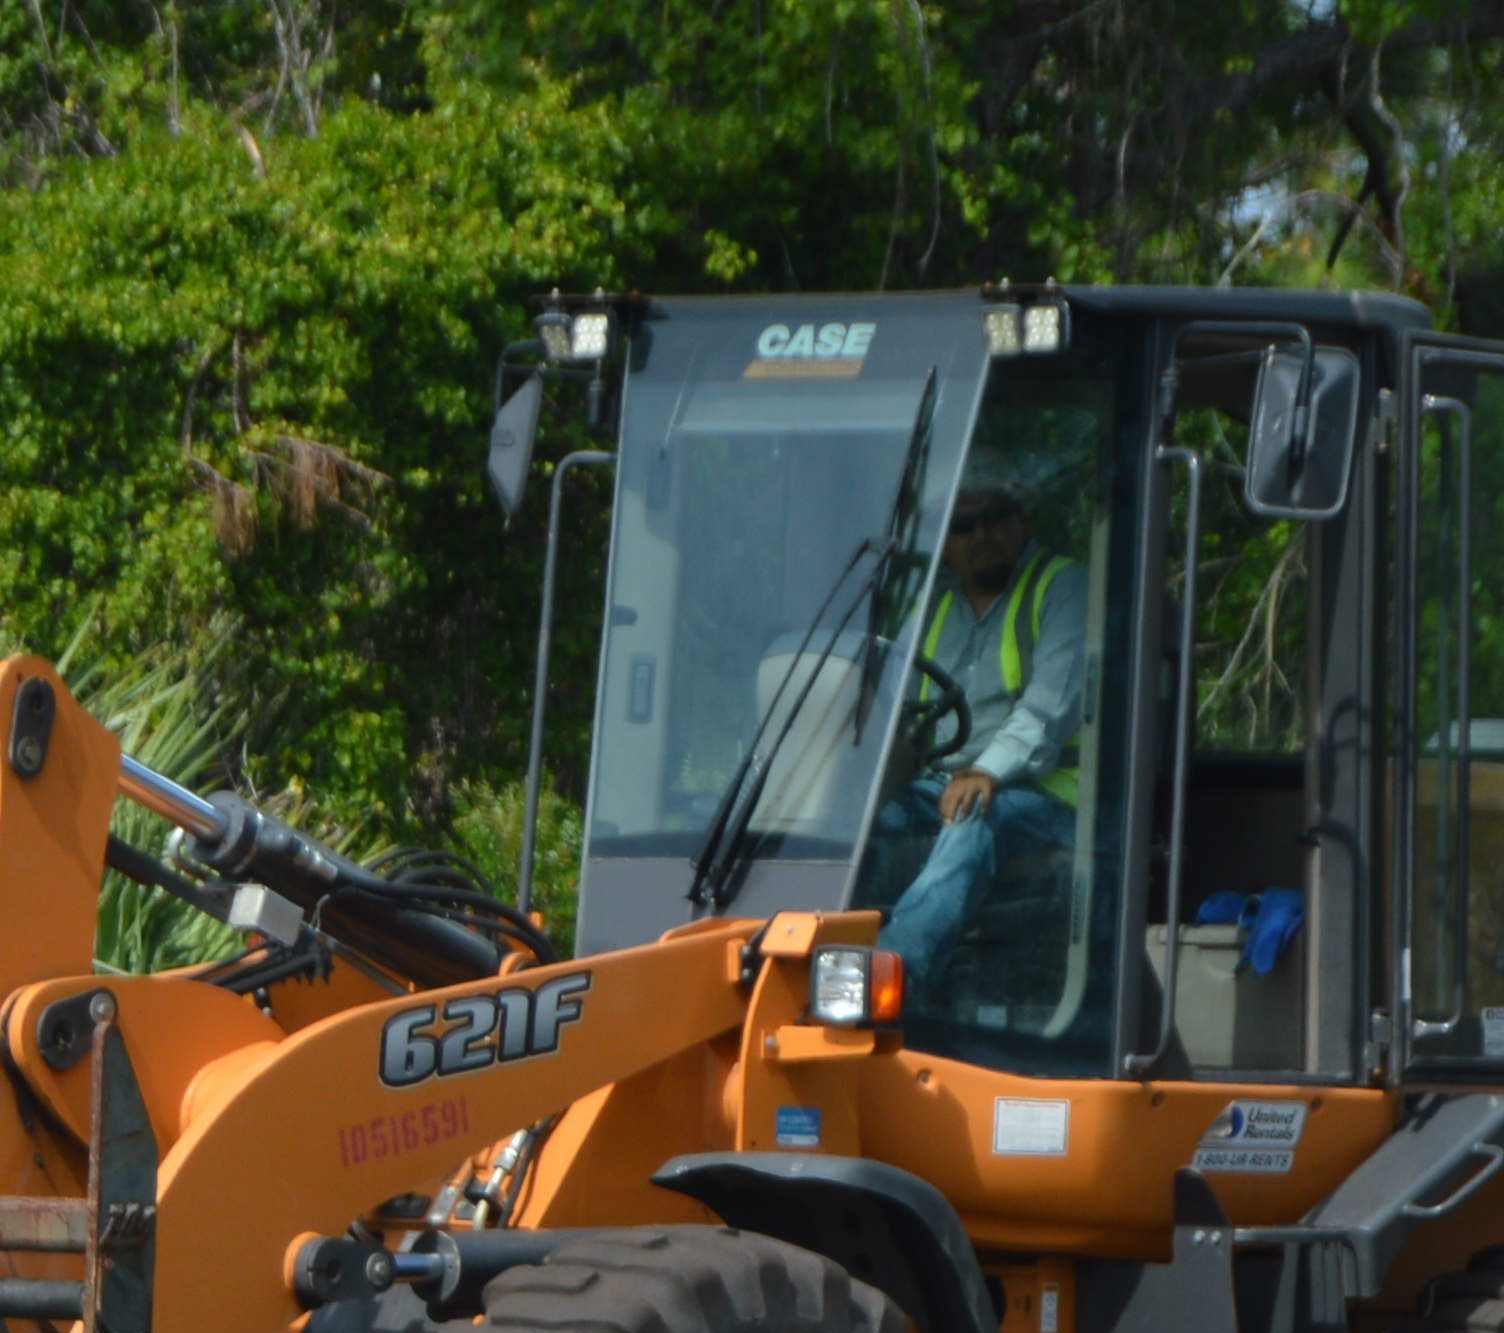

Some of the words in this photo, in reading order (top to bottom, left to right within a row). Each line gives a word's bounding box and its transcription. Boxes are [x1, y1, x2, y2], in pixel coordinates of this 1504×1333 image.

[758, 322, 876, 358] CASE
[379, 970, 592, 1088] 621F
[338, 1095, 470, 1169] 10516591
[1243, 1124, 1295, 1139] Rentals
[1248, 1106, 1297, 1124] United
